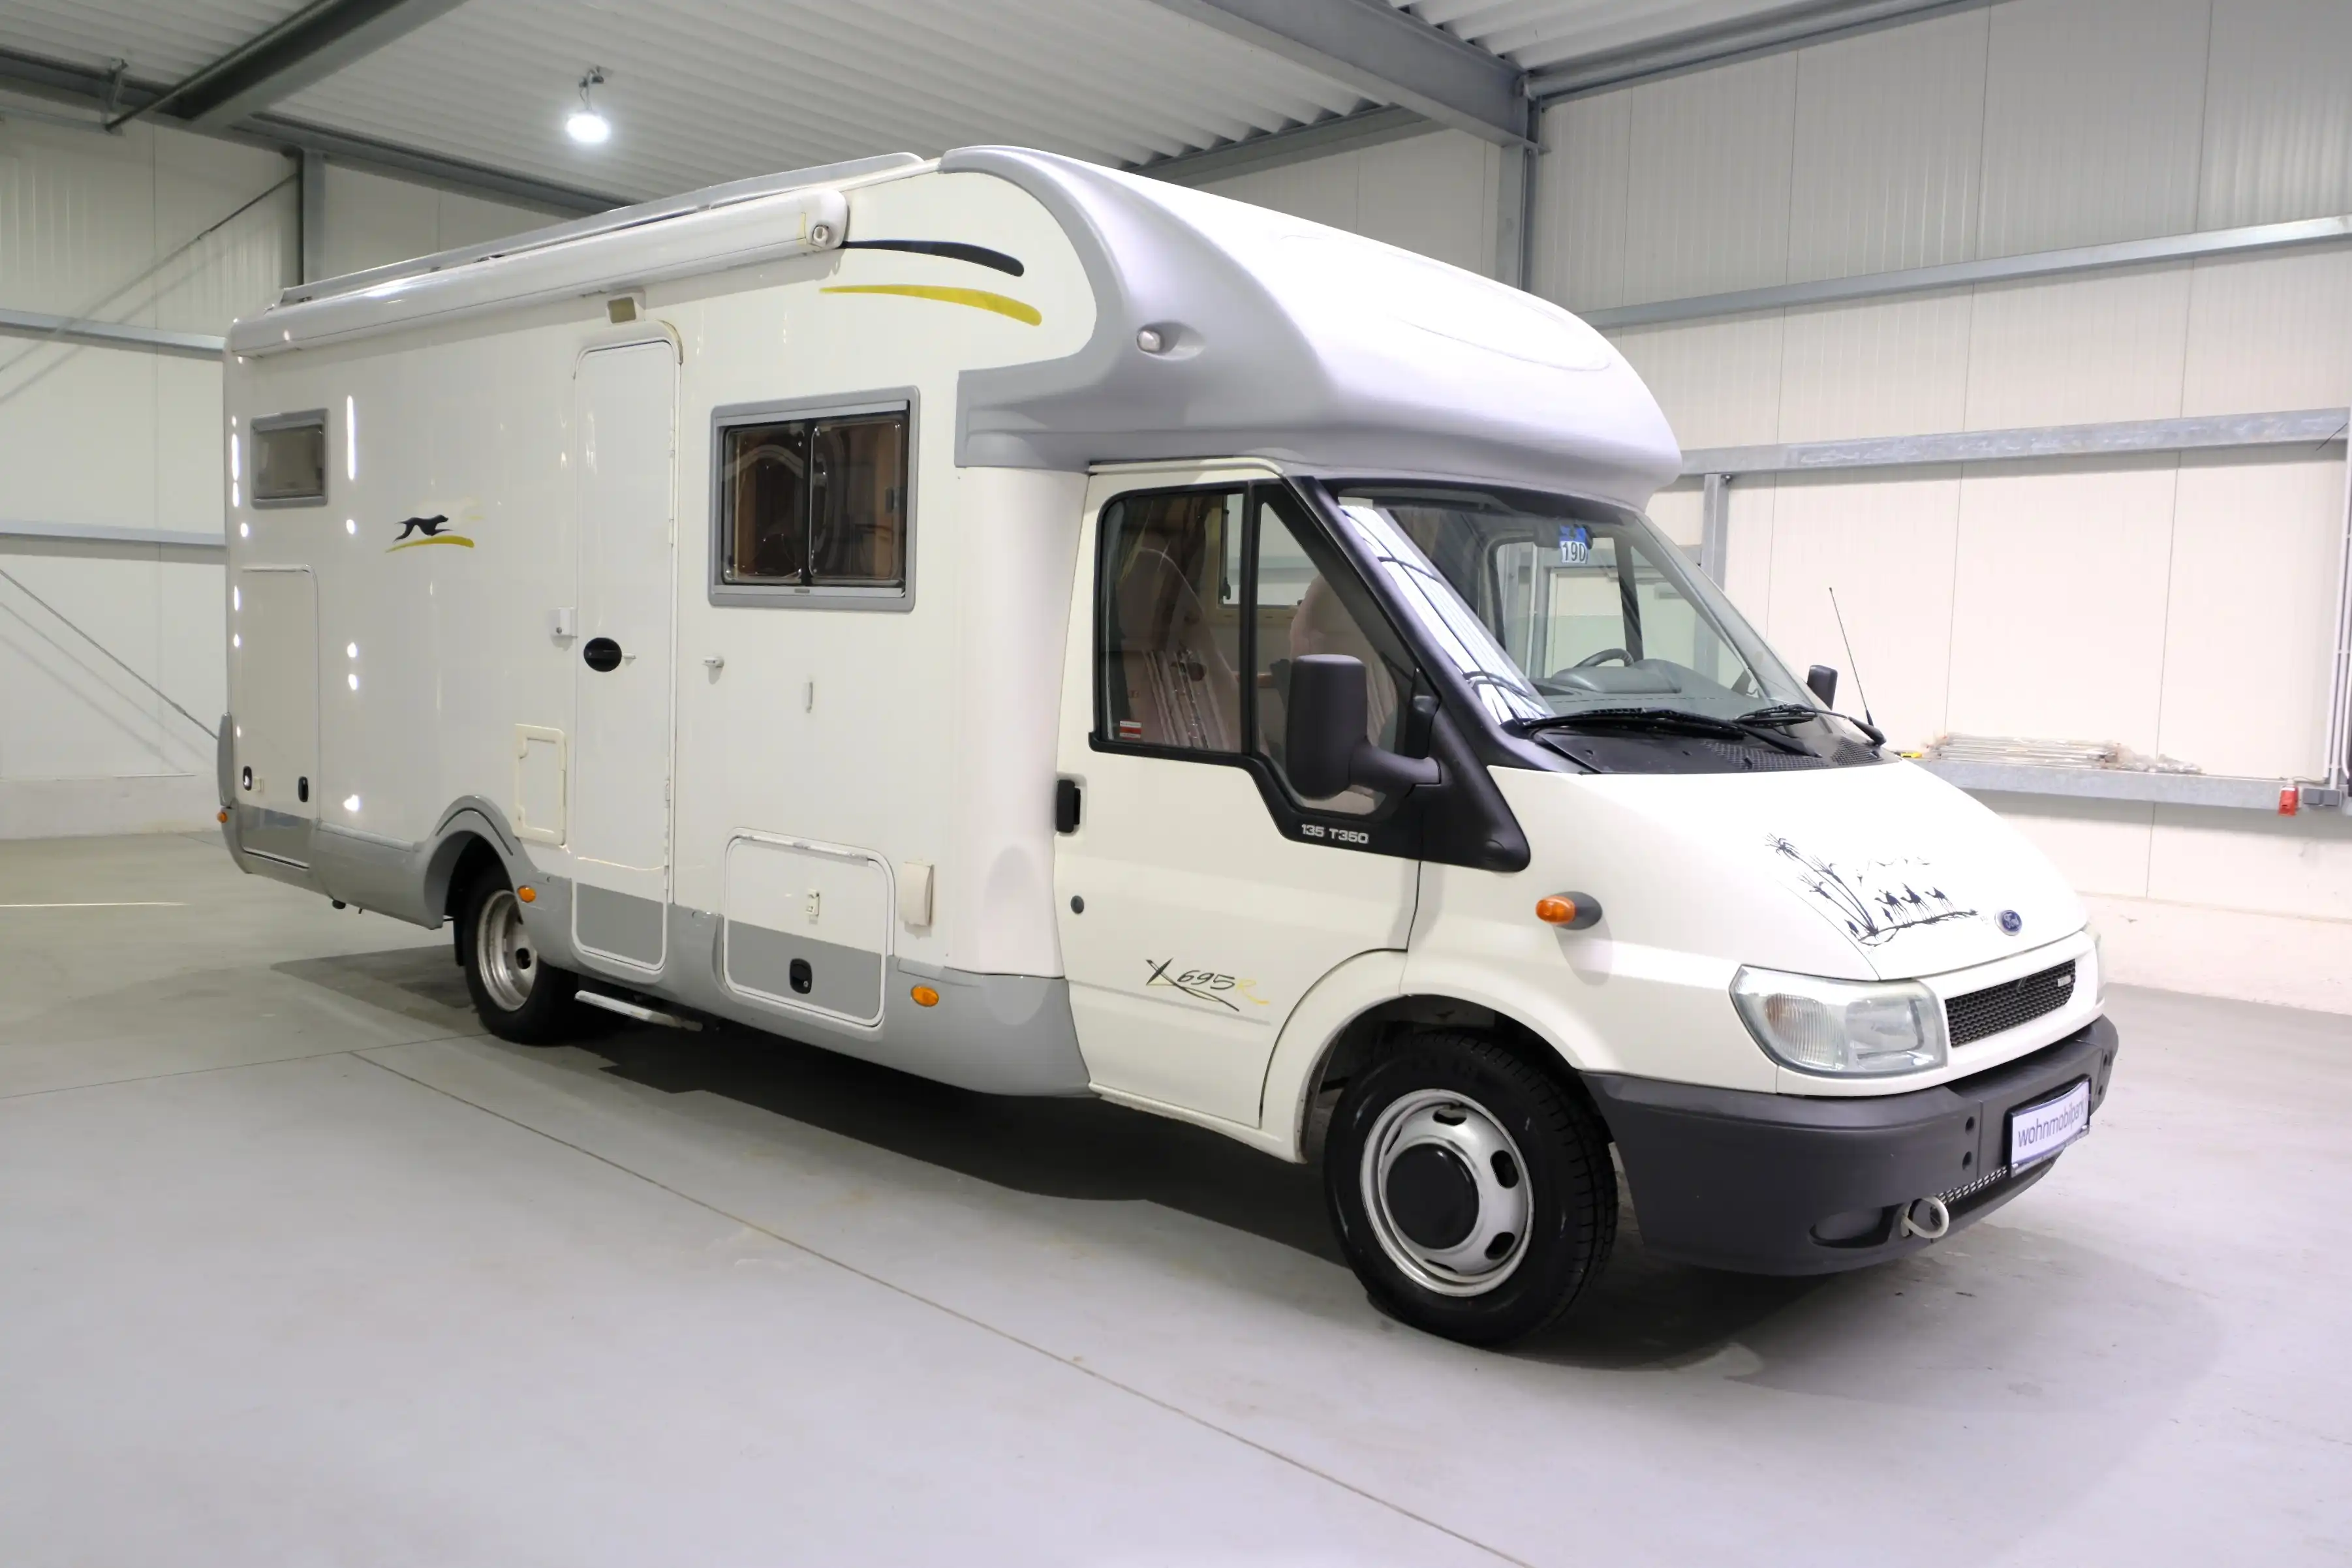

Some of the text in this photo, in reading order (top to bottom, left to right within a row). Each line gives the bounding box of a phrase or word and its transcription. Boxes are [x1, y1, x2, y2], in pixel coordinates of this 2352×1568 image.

[1562, 542, 1586, 562] 190
[1301, 823, 1369, 844] 135 T350
